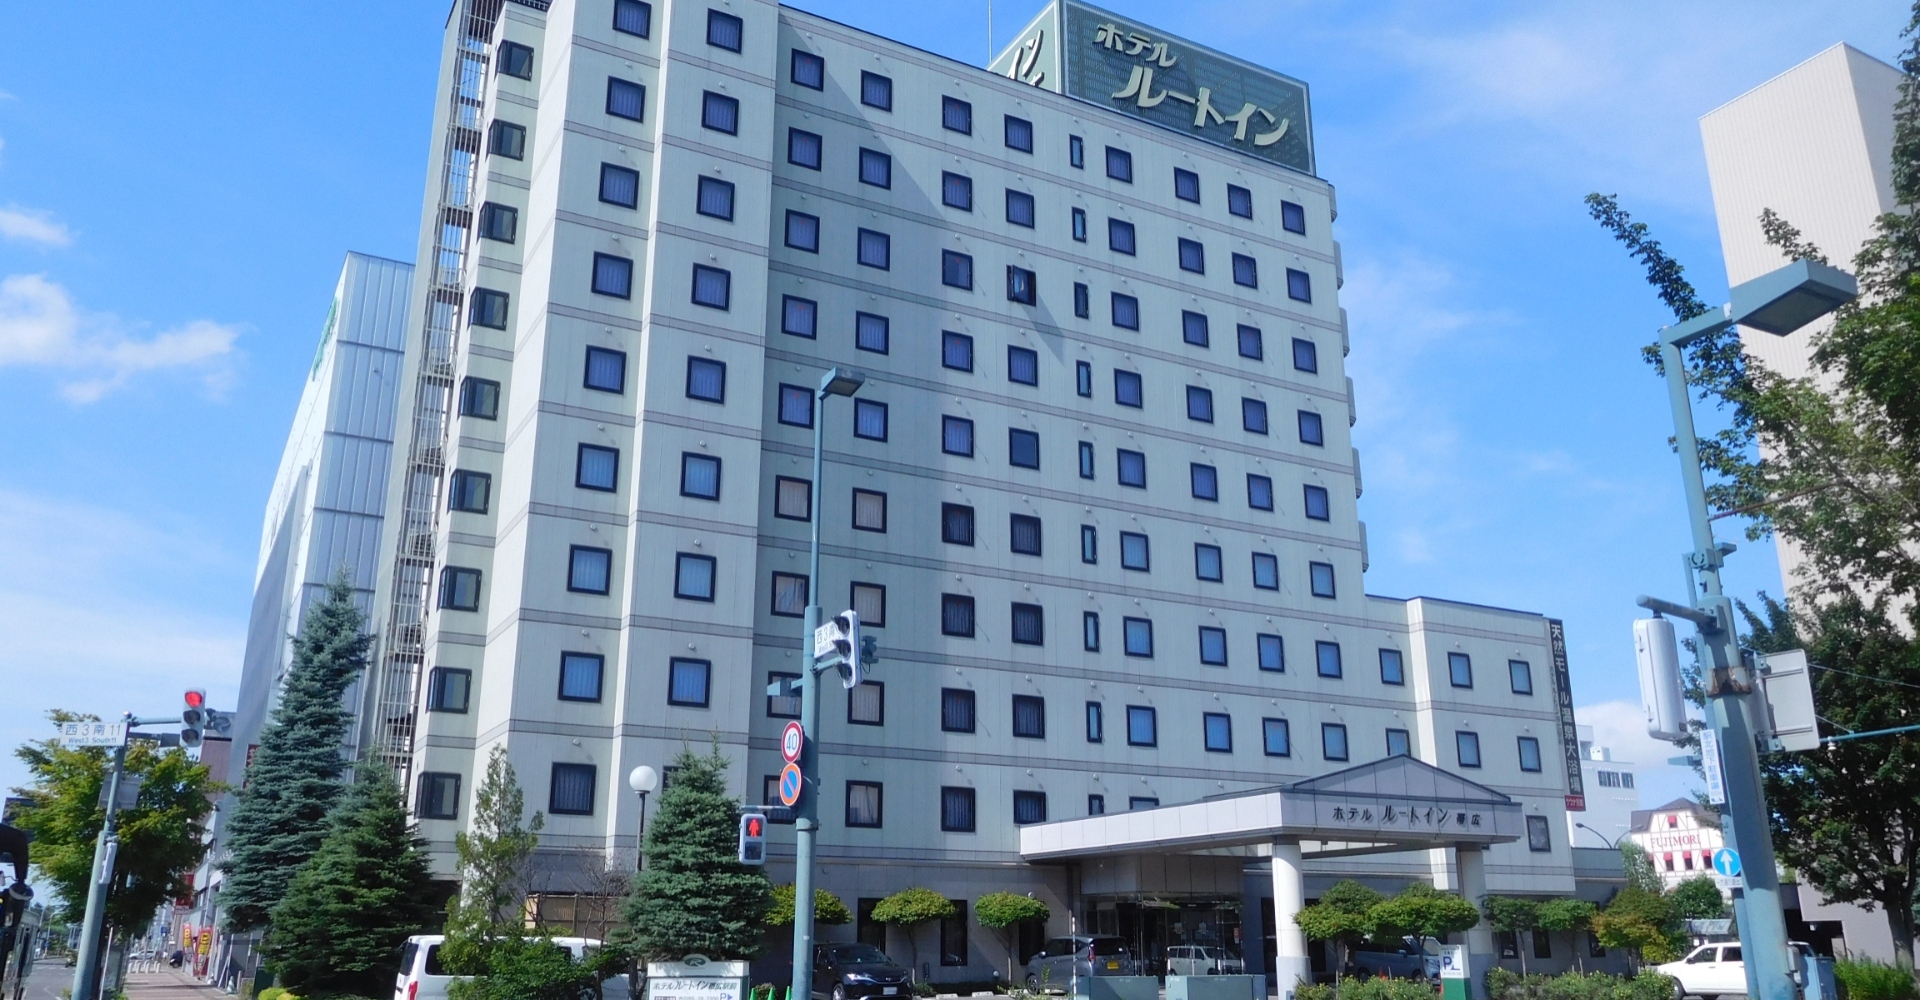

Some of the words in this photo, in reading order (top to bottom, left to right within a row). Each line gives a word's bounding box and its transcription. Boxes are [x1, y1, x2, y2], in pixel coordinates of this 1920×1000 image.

[1093, 23, 1177, 67] ホテル
[1111, 64, 1290, 147] ルートイン
[1551, 624, 1581, 792] 天然モール温泉大浴場
[787, 733, 798, 751] 40
[1333, 806, 1373, 821] ホテル
[1381, 805, 1449, 826] ルートイン
[1456, 812, 1482, 826] 帯広
[1650, 834, 1702, 848] FUJIMORI
[1443, 956, 1453, 970] P
